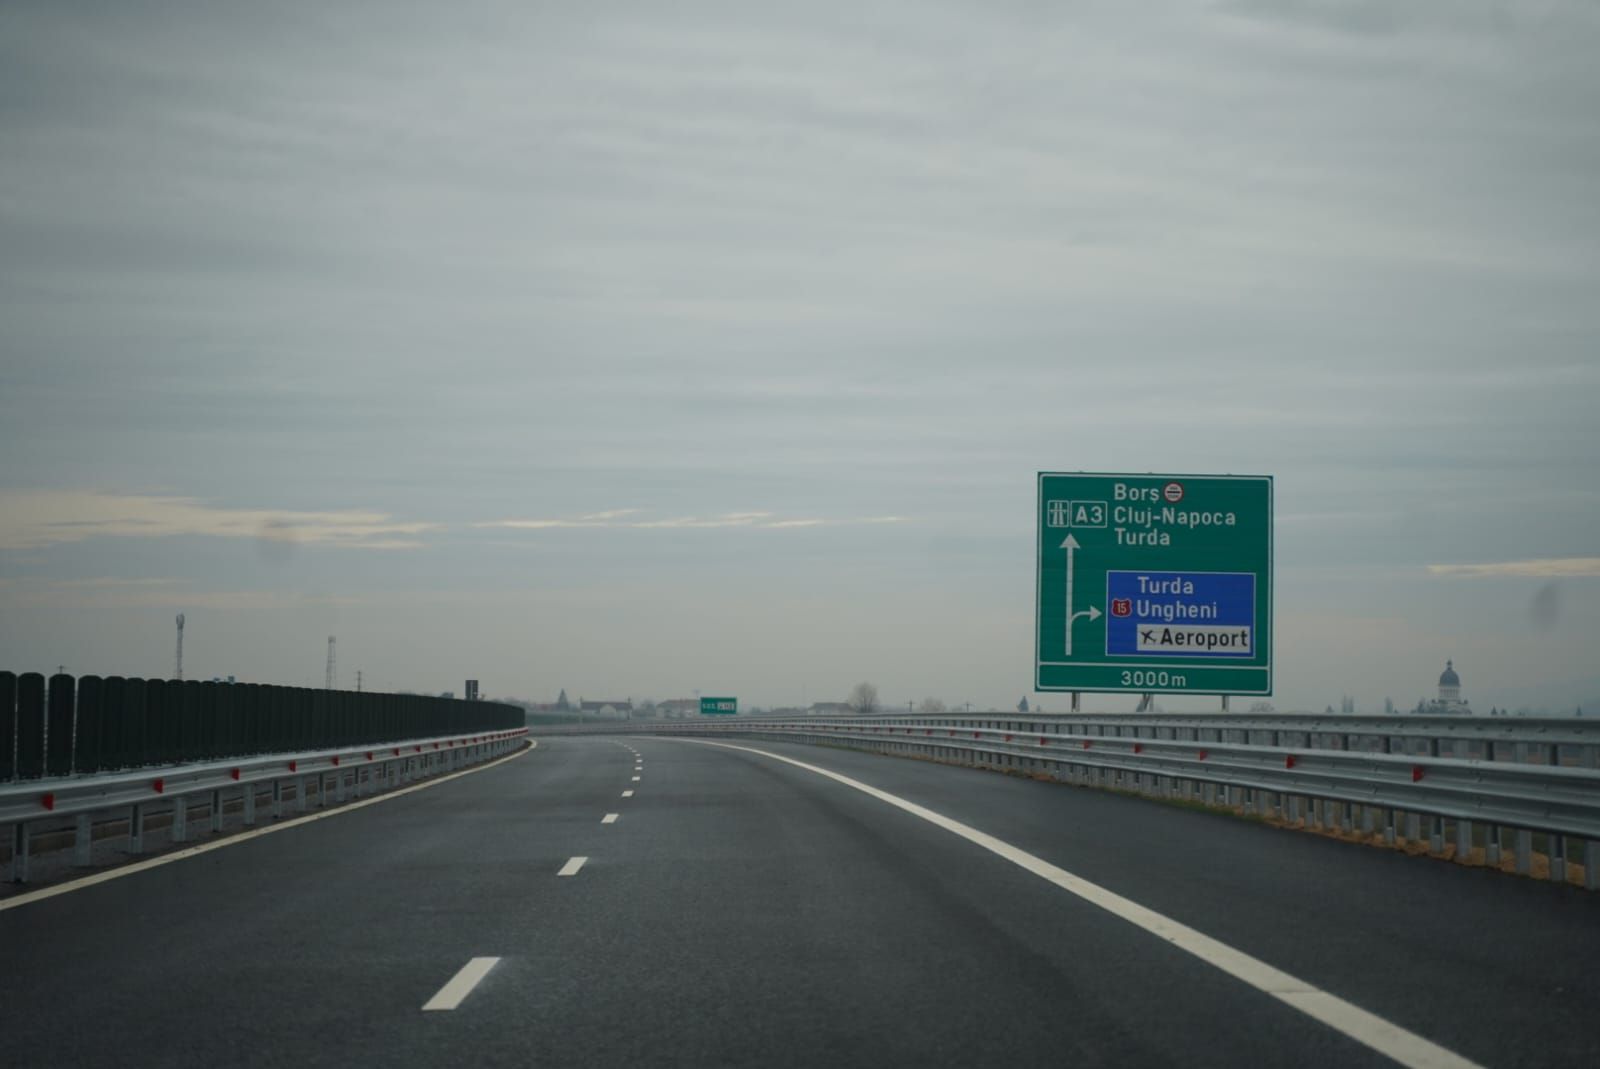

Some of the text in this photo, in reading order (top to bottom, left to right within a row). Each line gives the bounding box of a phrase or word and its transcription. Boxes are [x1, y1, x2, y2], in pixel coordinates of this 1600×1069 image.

[1075, 506, 1103, 523] A3
[1114, 507, 1236, 528] Cluj-Napoca
[1115, 528, 1170, 546] Turda
[1138, 576, 1194, 594] Turda
[1117, 602, 1127, 614] 15
[1137, 600, 1217, 622] Ungheni
[1160, 628, 1248, 650] Aeroport
